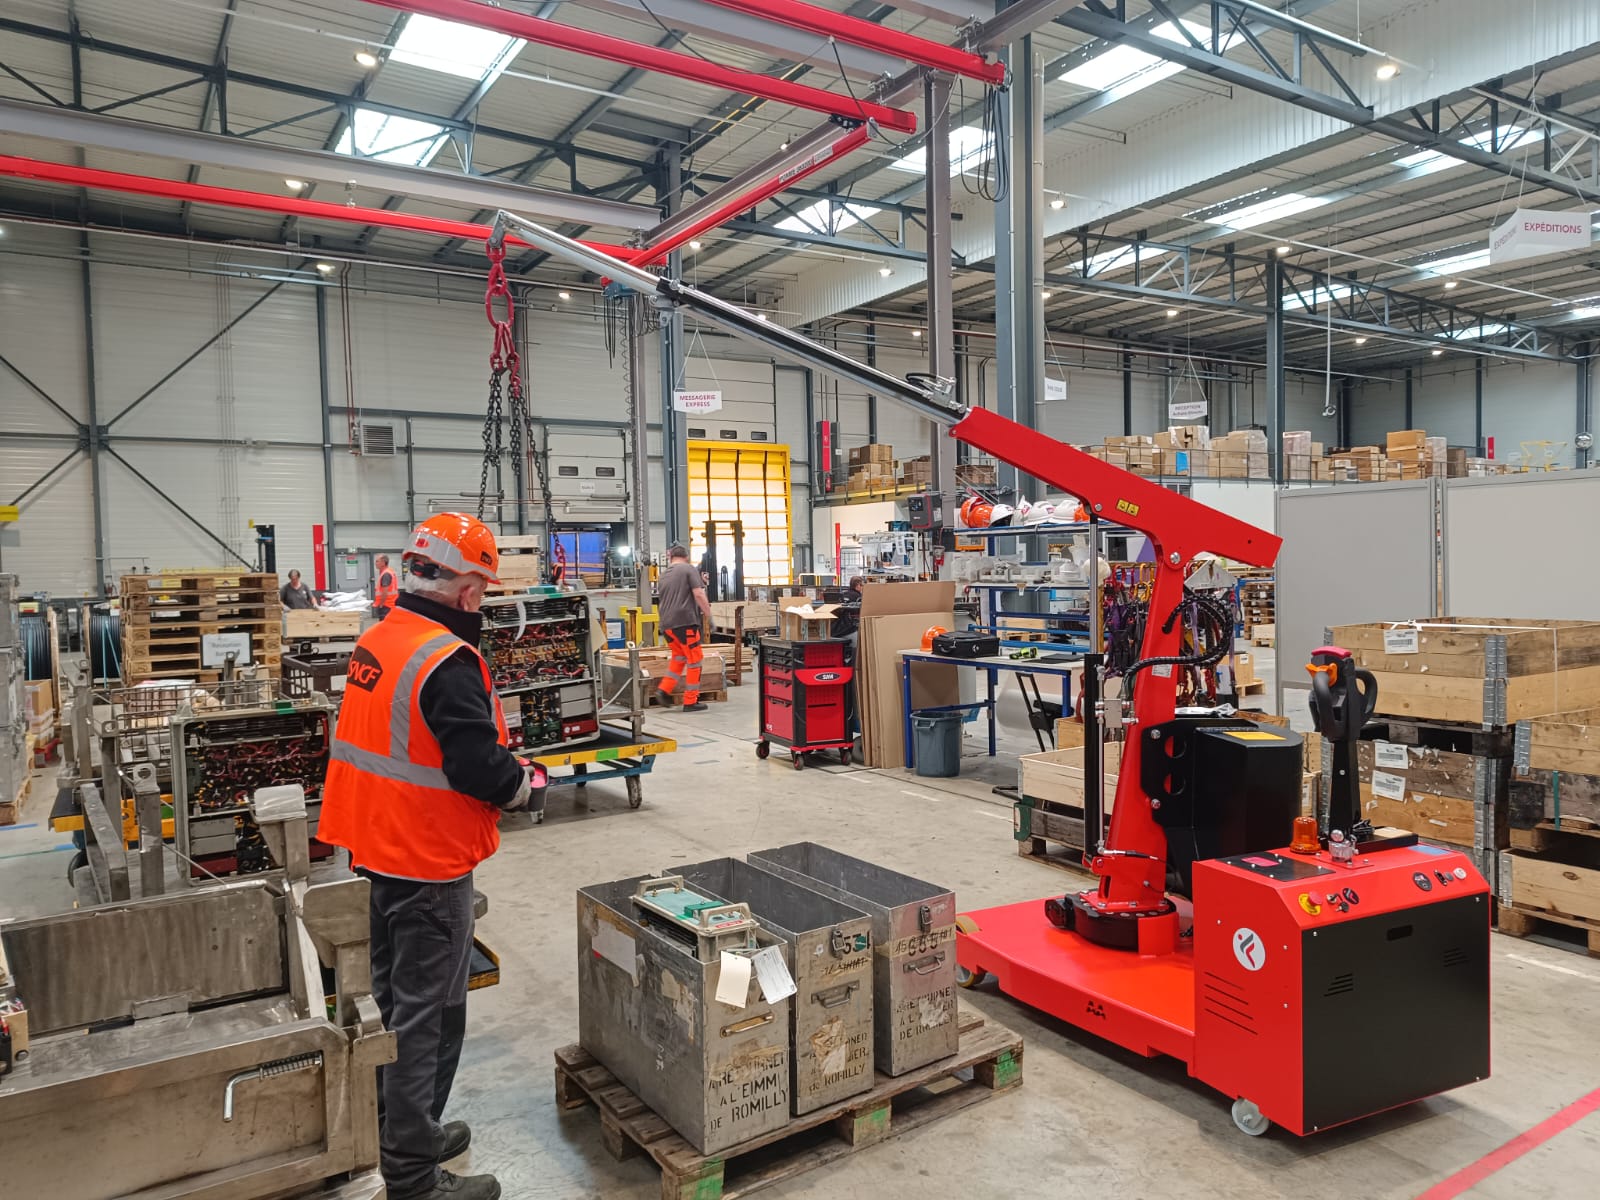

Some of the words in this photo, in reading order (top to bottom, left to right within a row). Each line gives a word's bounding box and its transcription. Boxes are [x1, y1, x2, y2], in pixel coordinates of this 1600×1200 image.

[1524, 222, 1582, 234] EXPÉDITIONS
[347, 661, 381, 684] SNCF
[710, 1116, 723, 1131] DE
[731, 1088, 789, 1124] ROMILLY
